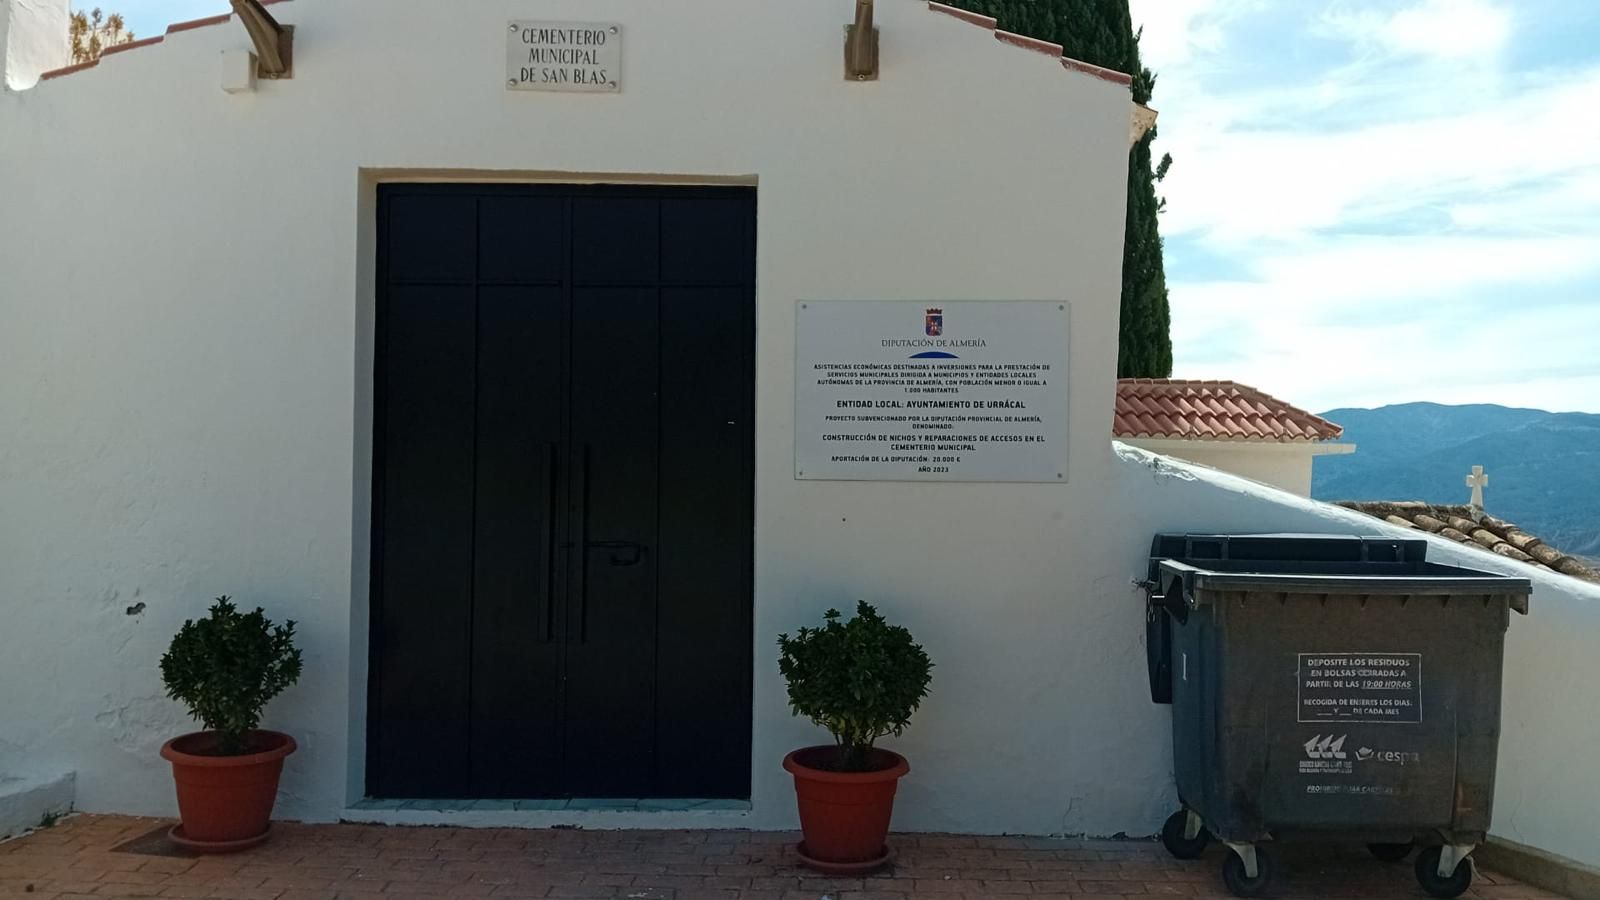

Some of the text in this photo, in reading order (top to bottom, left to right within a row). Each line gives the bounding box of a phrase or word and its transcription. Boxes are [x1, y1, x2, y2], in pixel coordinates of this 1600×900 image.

[522, 28, 606, 46] CEMENTERIO
[528, 48, 599, 65] MUNICIPAL
[520, 67, 606, 85] DE SAN BLAS
[881, 338, 934, 348] DIPUTACIÓN
[949, 338, 986, 348] ALMERÍA
[837, 399, 1026, 409] ENTIDAD LOCAL: AYUNTAMIENTO DE URRÁCAL
[822, 433, 876, 441] CONSTRUCCIÓN
[1307, 658, 1347, 666] DEPOSITE
[1368, 658, 1410, 666] RESIDUOS
[1324, 669, 1356, 677] BOLSAS
[1362, 680, 1384, 689] 19:00
[1384, 680, 1412, 689] HORAS
[1377, 751, 1420, 766] cespa
